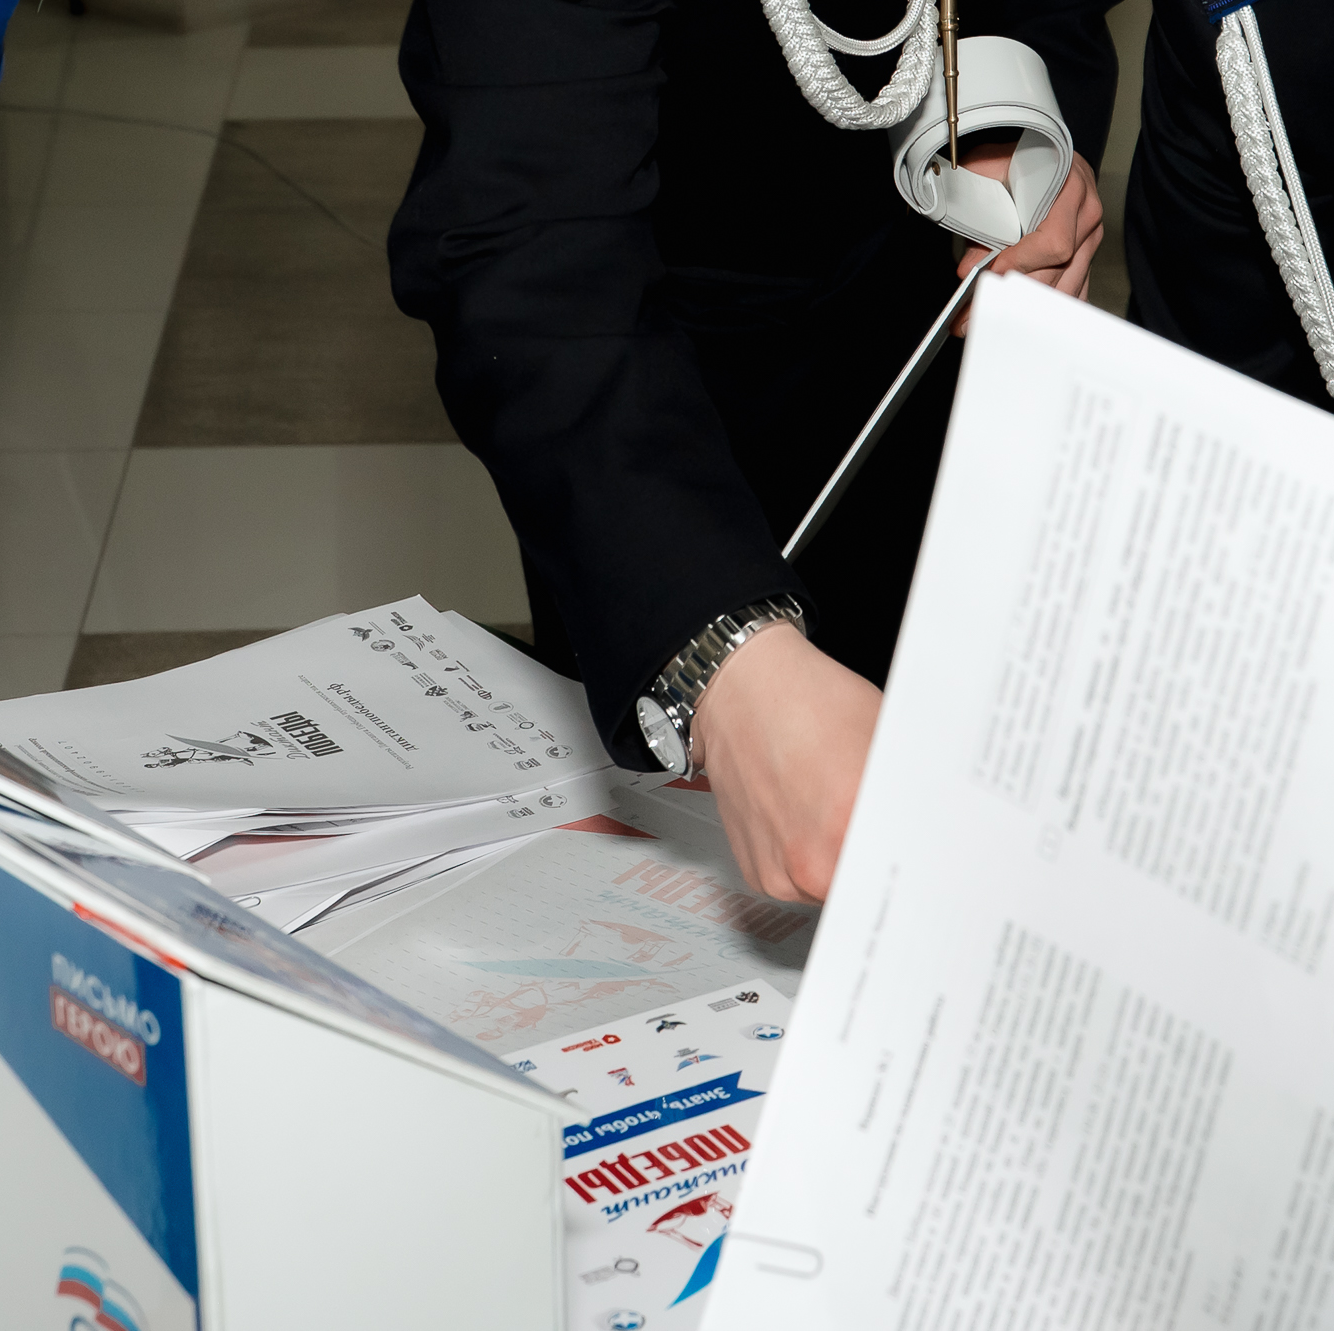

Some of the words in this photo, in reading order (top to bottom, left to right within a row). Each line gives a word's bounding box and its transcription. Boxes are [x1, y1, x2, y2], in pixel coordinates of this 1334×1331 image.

[269, 711, 344, 758] ПОБЕДЫ
[327, 682, 419, 752] диктантпобеды.рф
[611, 858, 811, 945] ПОБЕДЫ
[51, 951, 162, 1048] ПИСЬМО
[54, 993, 142, 1077] ГЕРОЮ
[595, 1108, 662, 1137] чтобы
[661, 1085, 731, 1113] Знать,
[562, 1124, 752, 1205] ПОБЕДЫ
